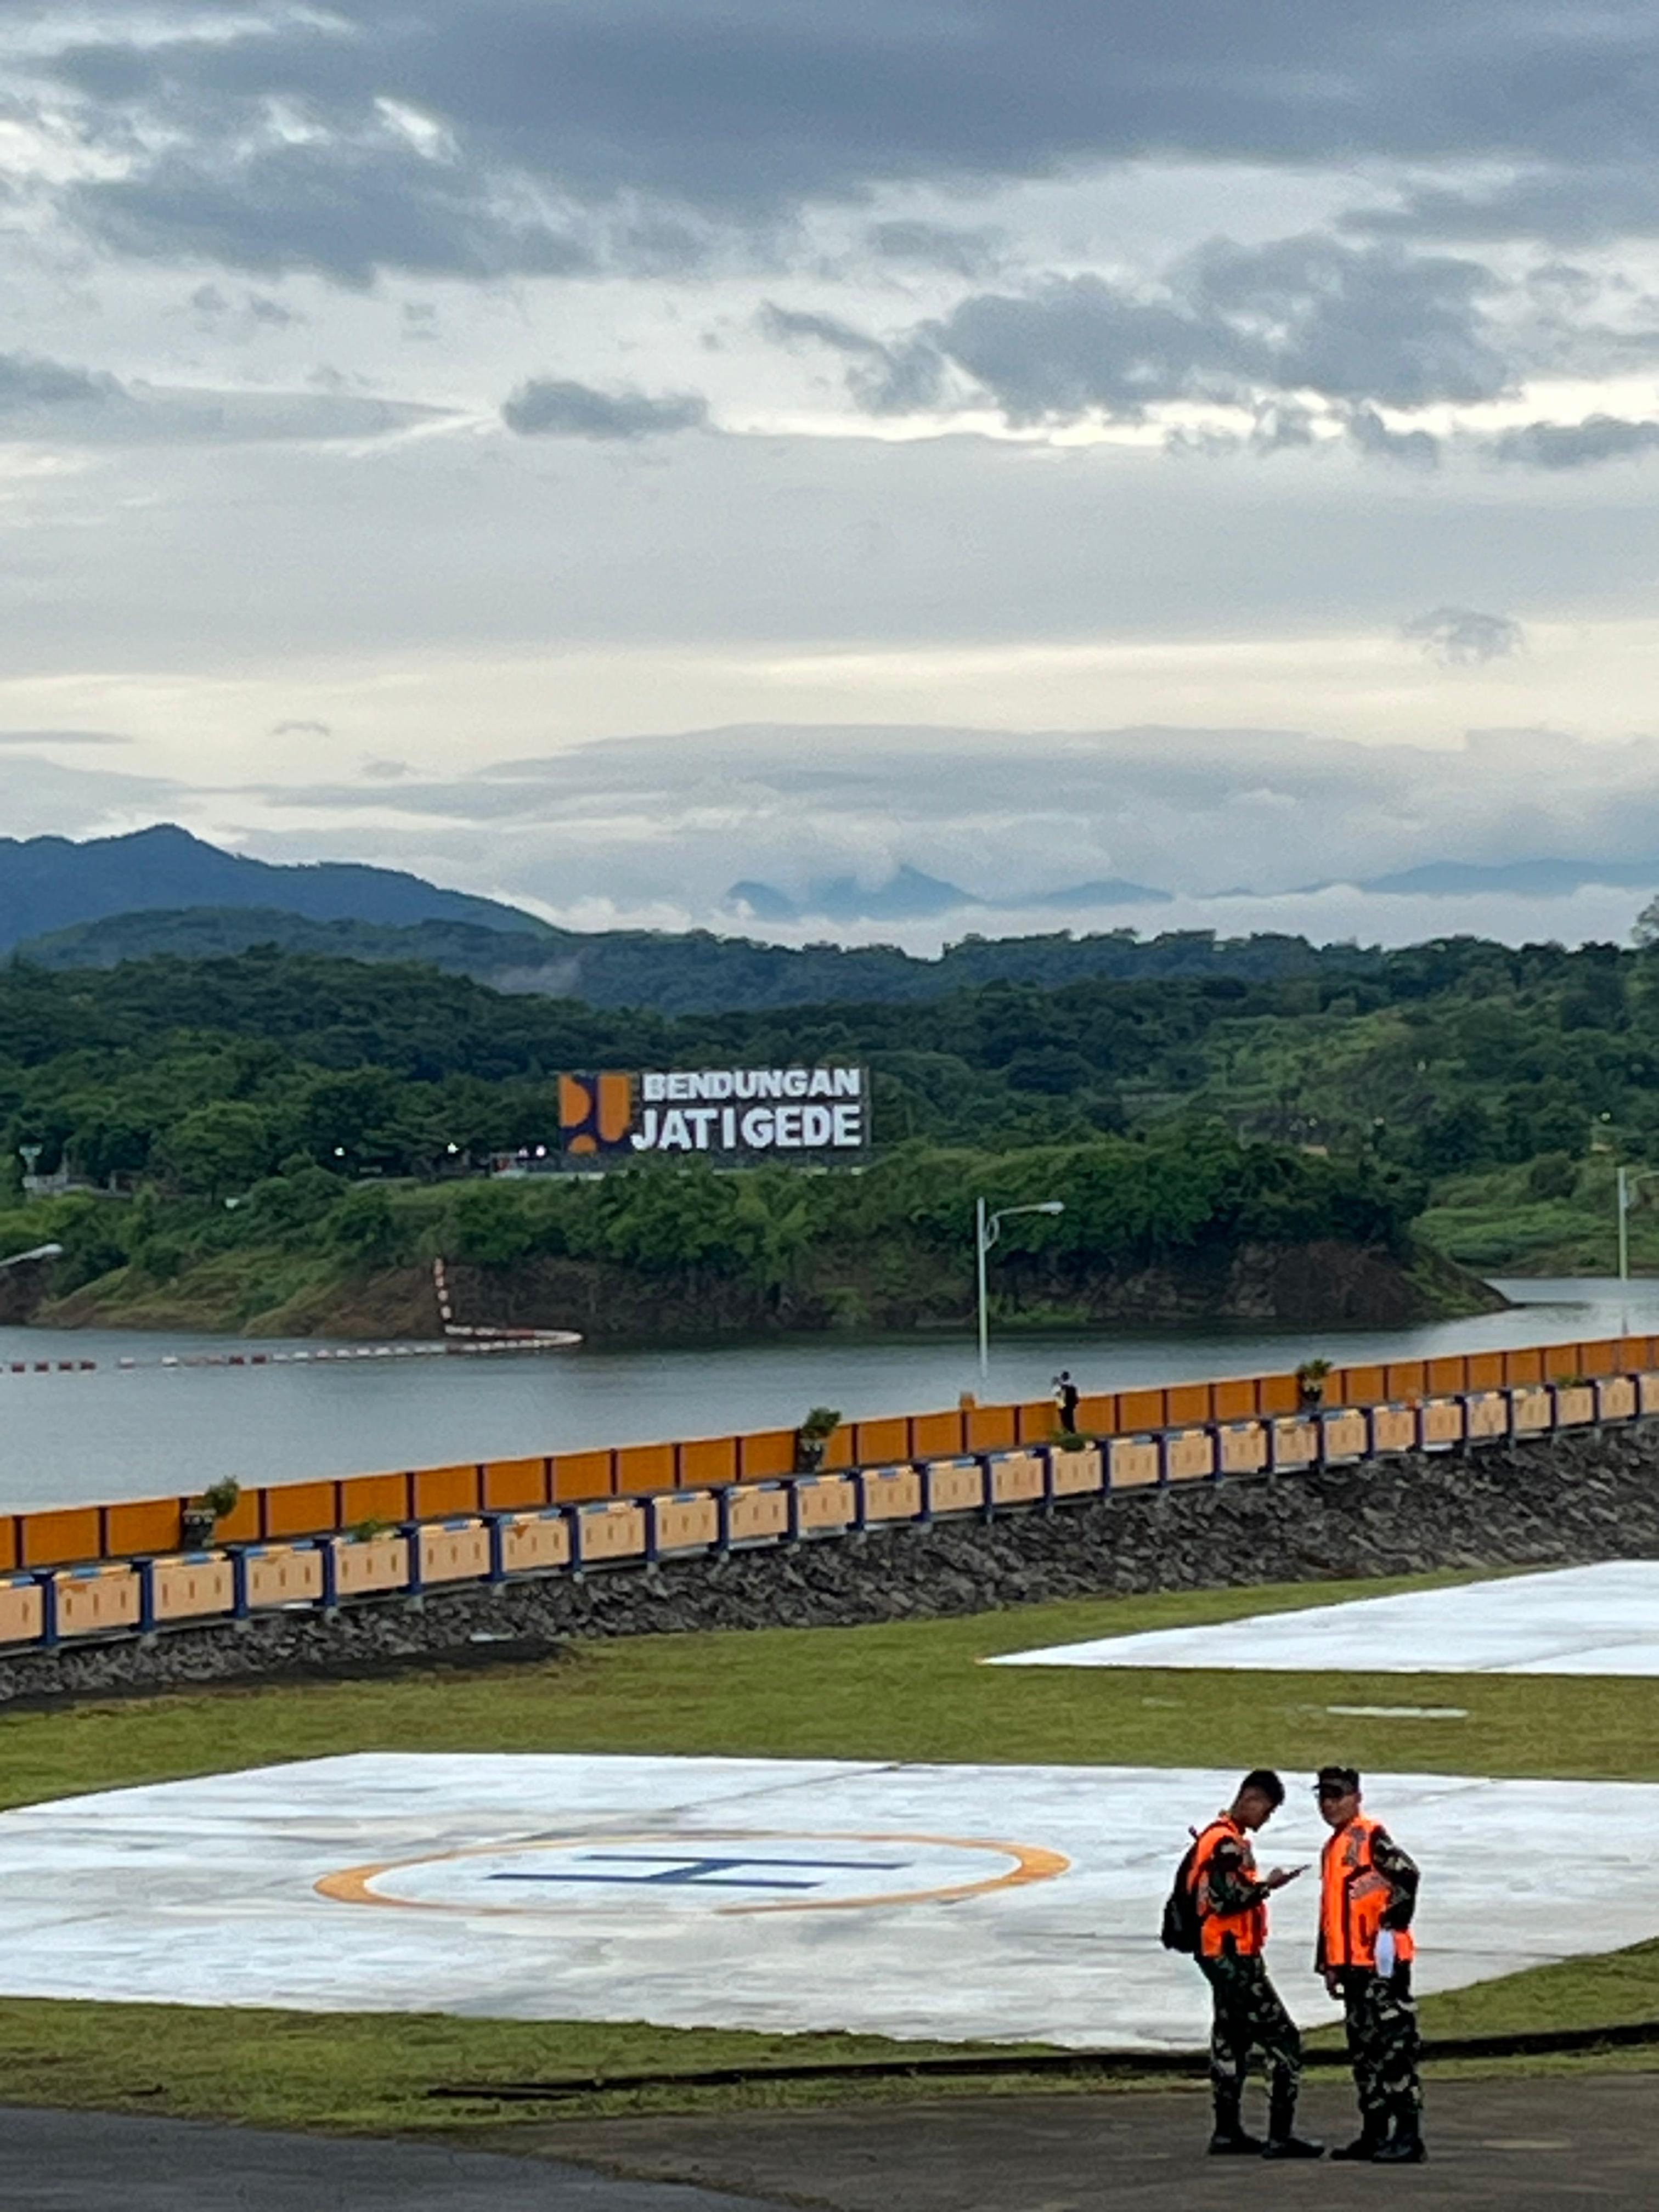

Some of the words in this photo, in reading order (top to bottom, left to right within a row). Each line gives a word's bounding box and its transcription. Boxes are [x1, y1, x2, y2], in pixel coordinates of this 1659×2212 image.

[642, 1068, 860, 1102] BENDUNGAN
[630, 1104, 862, 1150] JATIGEDE
[487, 1854, 911, 1889] H
